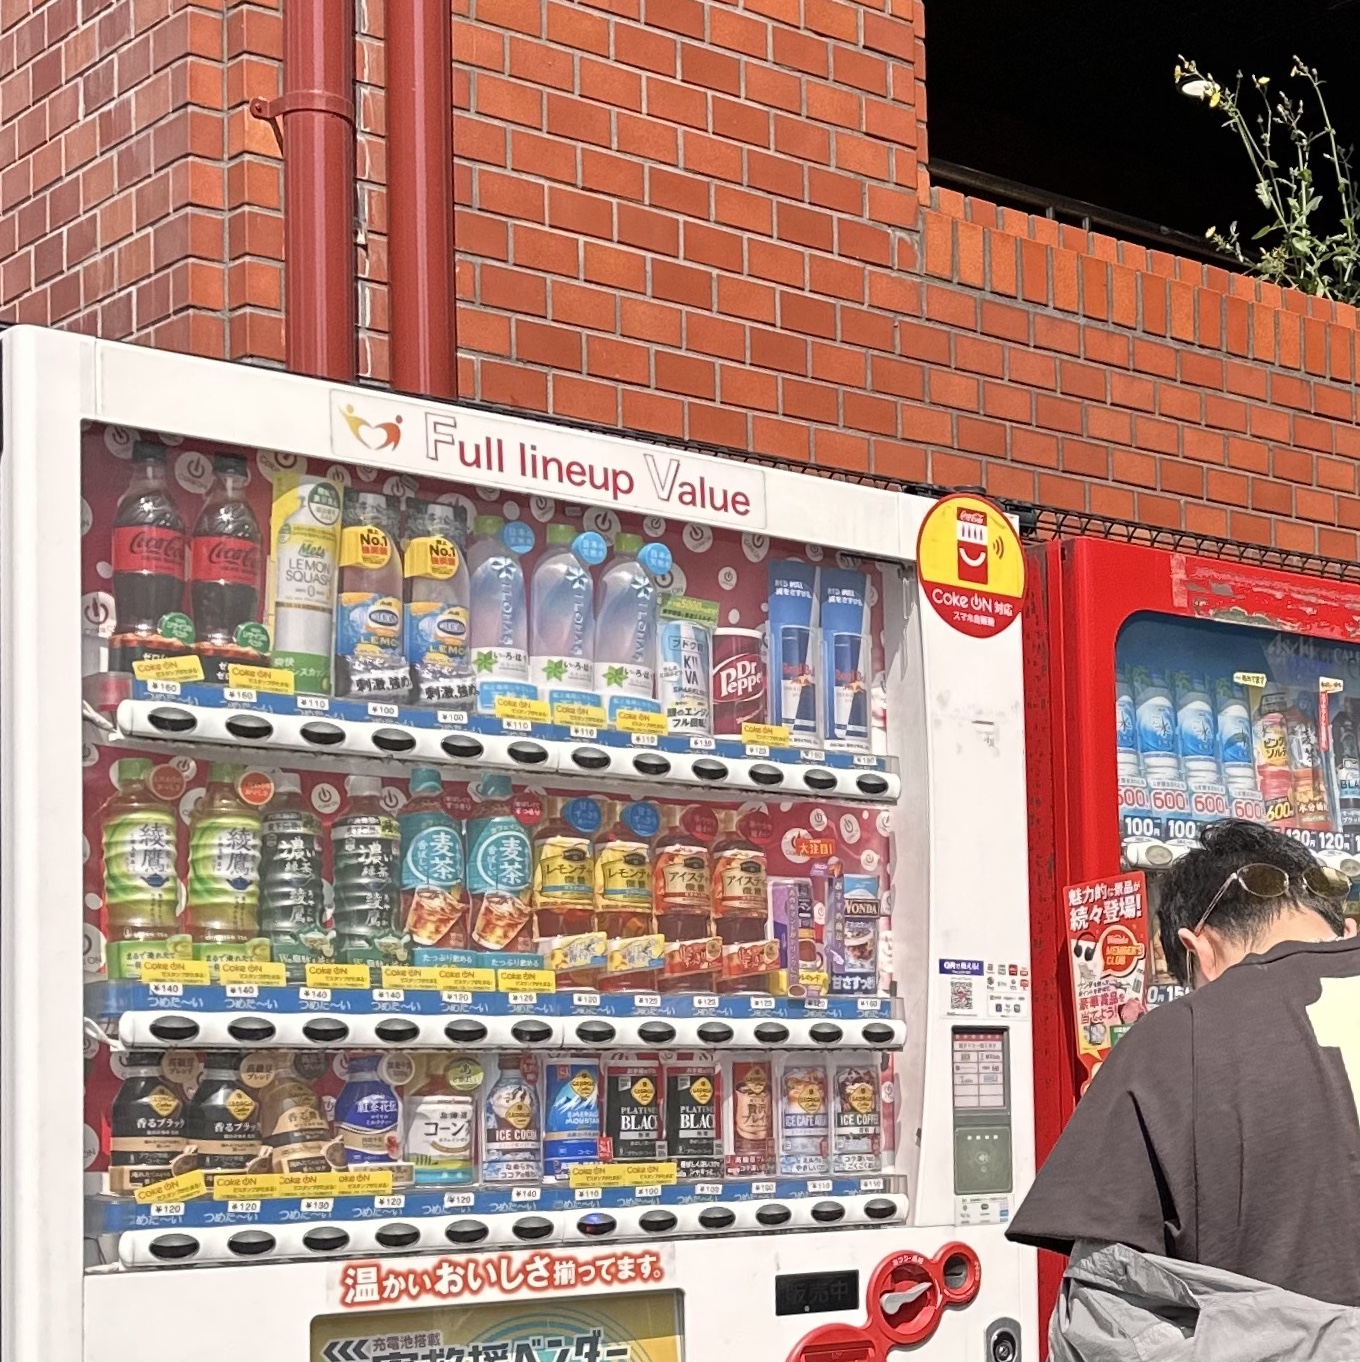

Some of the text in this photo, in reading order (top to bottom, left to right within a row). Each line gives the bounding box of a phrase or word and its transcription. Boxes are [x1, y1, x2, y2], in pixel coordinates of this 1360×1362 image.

[425, 412, 751, 517] Full lineup Value
[289, 558, 331, 574] LEMON
[932, 588, 968, 607] Coke
[970, 593, 993, 614] ON
[735, 661, 757, 678] Dr
[151, 682, 178, 693] ¥160
[229, 690, 254, 700] ¥160
[301, 699, 326, 709] ¥110
[372, 706, 395, 715] ¥100
[442, 713, 465, 722] ¥100
[507, 721, 529, 730] ¥110
[1341, 780, 1360, 789] BLA
[1153, 791, 1187, 811] 600
[1194, 794, 1226, 813] 600
[1267, 802, 1291, 822] 600
[140, 823, 166, 873] 綾鷹
[226, 827, 253, 875] 綾鷹
[430, 832, 454, 883] 麦茶
[500, 837, 525, 883] 麦茶
[1070, 894, 1142, 931] 続々登場!
[144, 962, 168, 970] Coke
[223, 964, 245, 972] Coke
[310, 966, 331, 975] Coke
[385, 968, 406, 977] Coke
[153, 985, 179, 994] ¥140
[229, 986, 255, 995] ¥140
[303, 990, 328, 999] ¥140
[378, 991, 401, 1000] ¥140
[621, 1114, 658, 1131] BLAC
[680, 1113, 714, 1129] BLAC
[840, 1114, 855, 1125] ICE
[496, 1130, 512, 1141] ICE
[217, 1177, 240, 1187] Coke
[339, 1174, 355, 1183] oke
[138, 1186, 162, 1201] Coke
[516, 1190, 537, 1198] ¥140
[231, 1202, 257, 1211] ¥120
[379, 1198, 402, 1206] ¥120
[155, 1205, 181, 1214] ¥120
[343, 1254, 664, 1304] 温かいおいしさ揃ってます。
[372, 1332, 441, 1352] 充電池搭載
